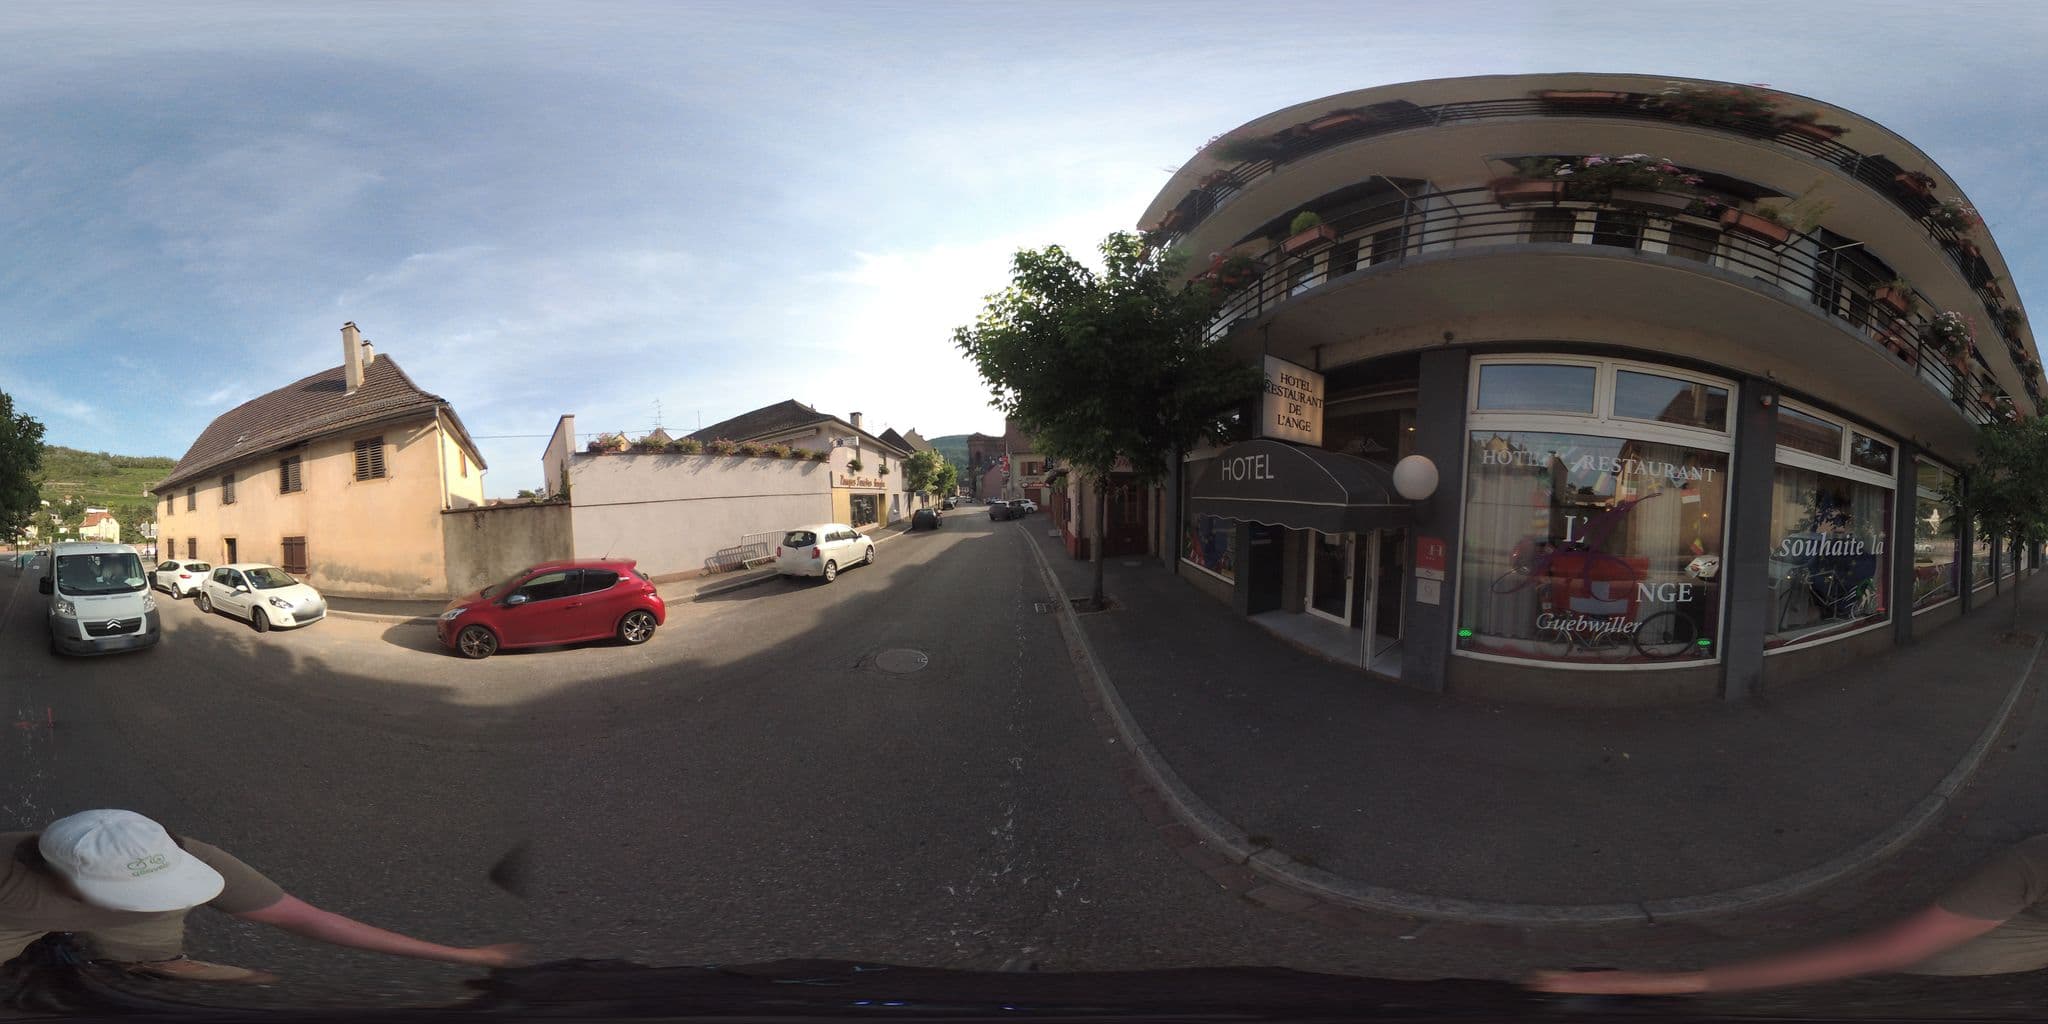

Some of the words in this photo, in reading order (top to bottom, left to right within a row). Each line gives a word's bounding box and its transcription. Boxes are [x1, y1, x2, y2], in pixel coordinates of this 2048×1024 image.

[1264, 379, 1323, 408] RESTAURANT
[1280, 373, 1312, 393] HOTEL
[1288, 402, 1302, 416] DE
[1277, 414, 1312, 432] L'ANGE
[1222, 453, 1275, 480] HOTEL
[1580, 454, 1716, 482] RESTAURANT
[1780, 532, 1865, 557] souhaite
[1871, 535, 1884, 555] la
[1636, 582, 1693, 603] NGE
[1536, 612, 1642, 633] Guebwiller
